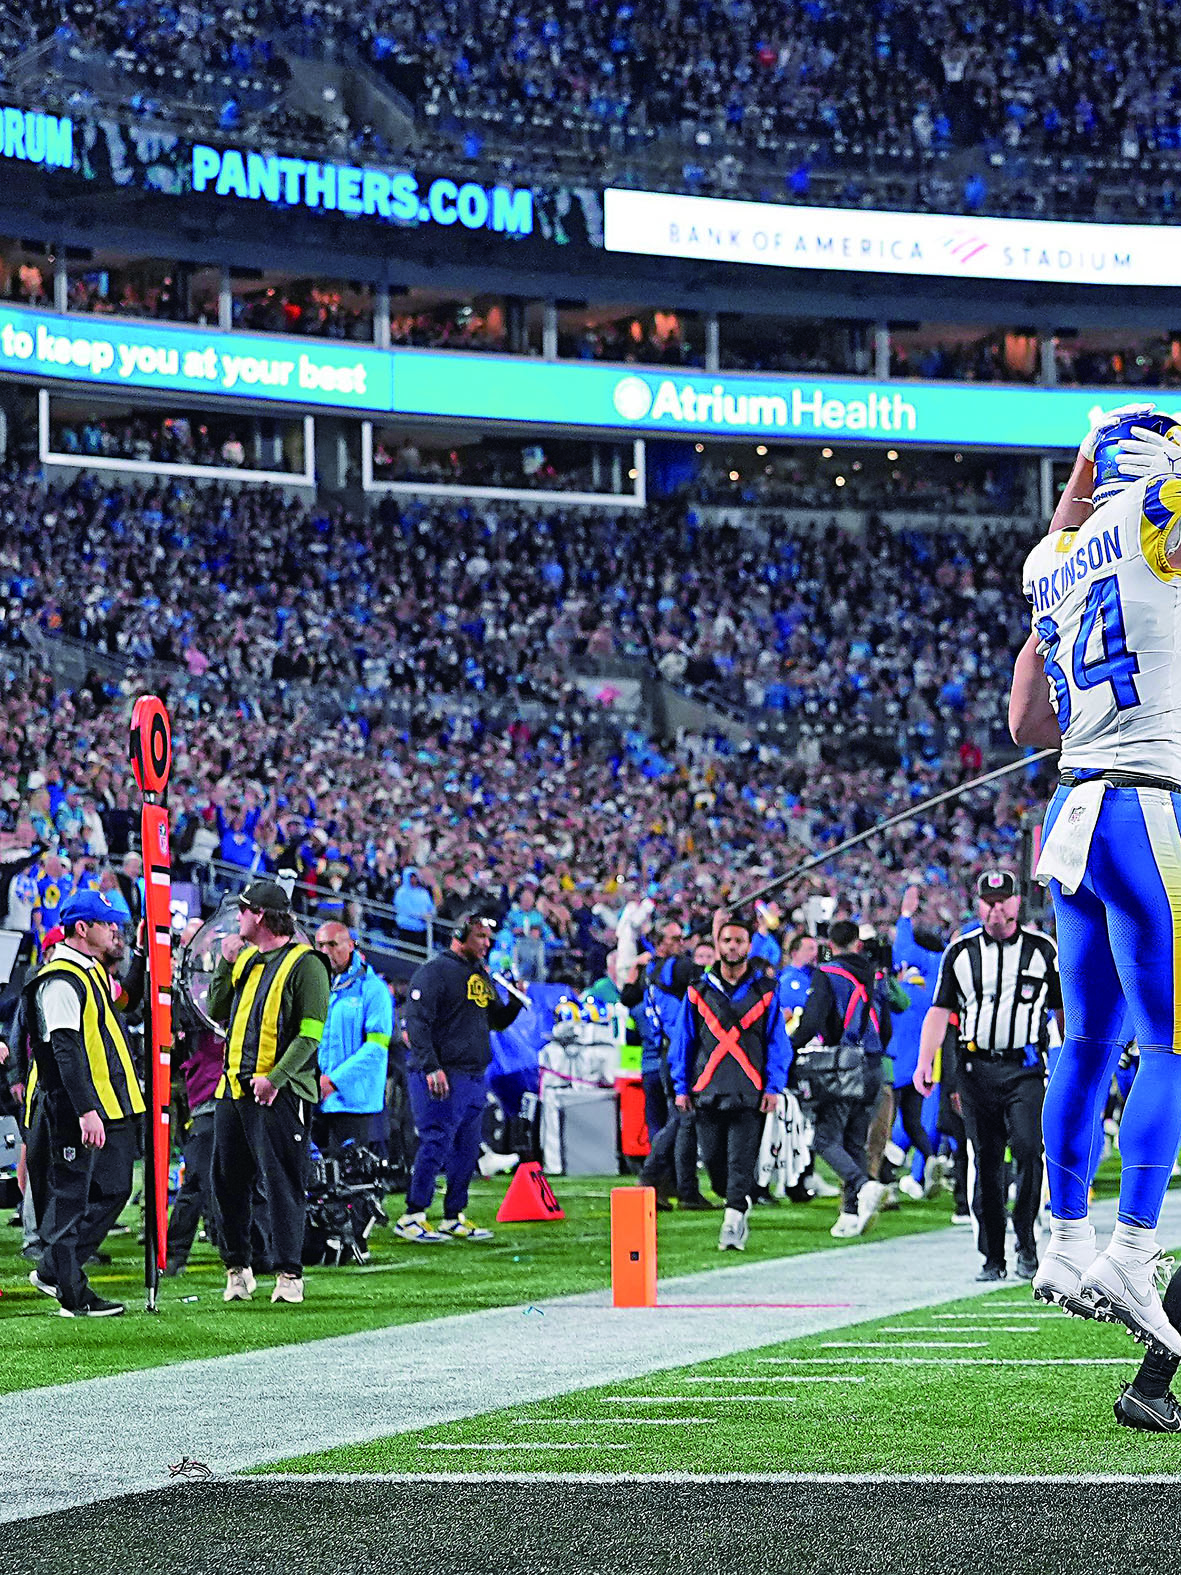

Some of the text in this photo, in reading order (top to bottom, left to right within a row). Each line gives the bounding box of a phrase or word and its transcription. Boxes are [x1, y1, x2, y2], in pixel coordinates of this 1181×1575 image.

[0, 106, 74, 168] RUM
[192, 145, 534, 235] PANTHERS.COM
[669, 222, 923, 260] BANK OF AMERICA
[1003, 247, 1131, 271] STADIUM
[2, 323, 367, 394] to keep you at your best
[651, 380, 917, 431] Atrium Health
